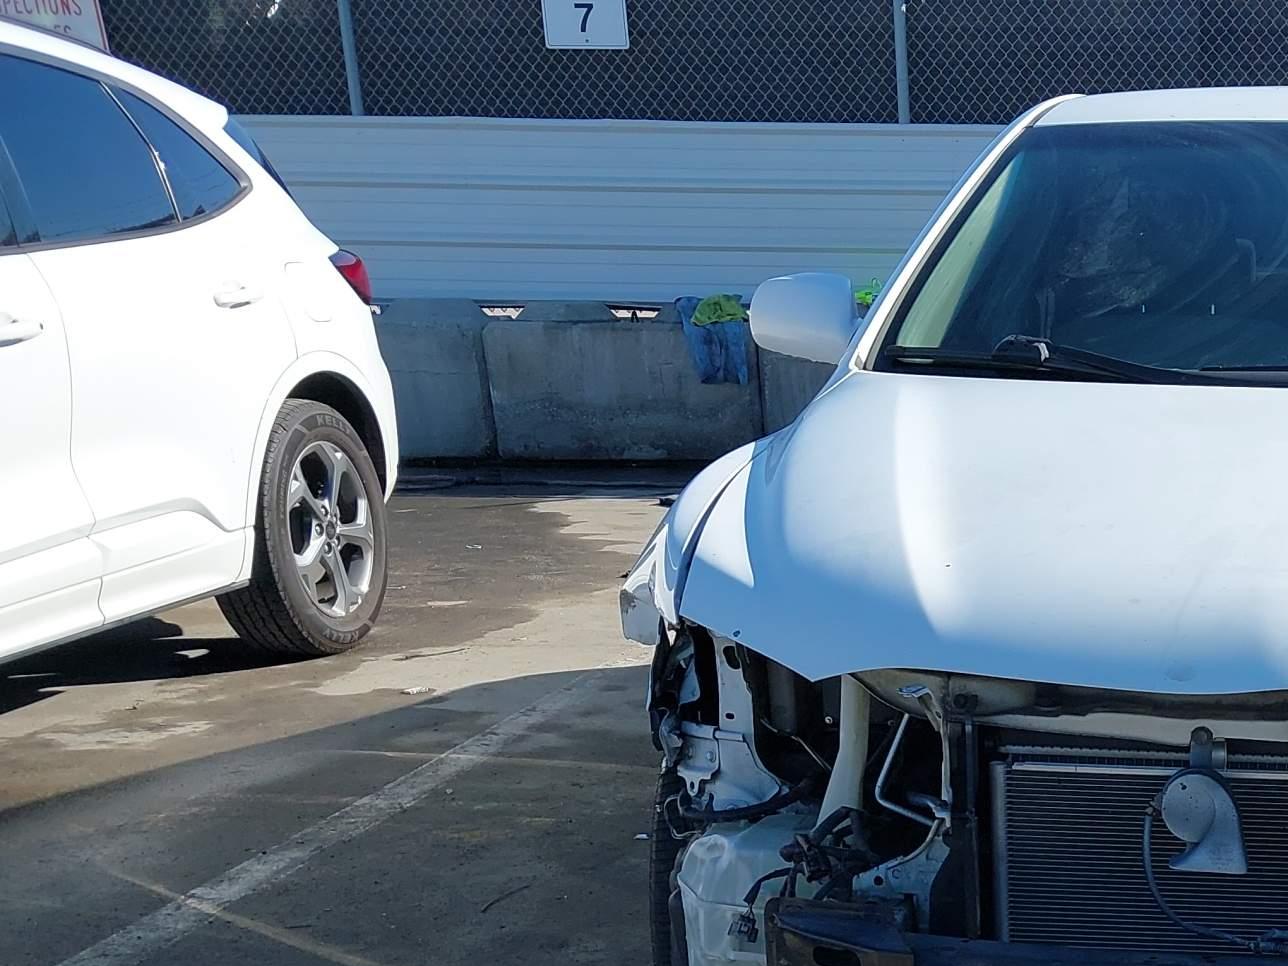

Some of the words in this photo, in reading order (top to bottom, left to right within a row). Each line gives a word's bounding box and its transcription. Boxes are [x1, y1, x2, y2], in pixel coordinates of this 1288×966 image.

[0, 0, 82, 16] PECTIONS
[574, 3, 594, 32] 7
[322, 628, 360, 643] KELLY
